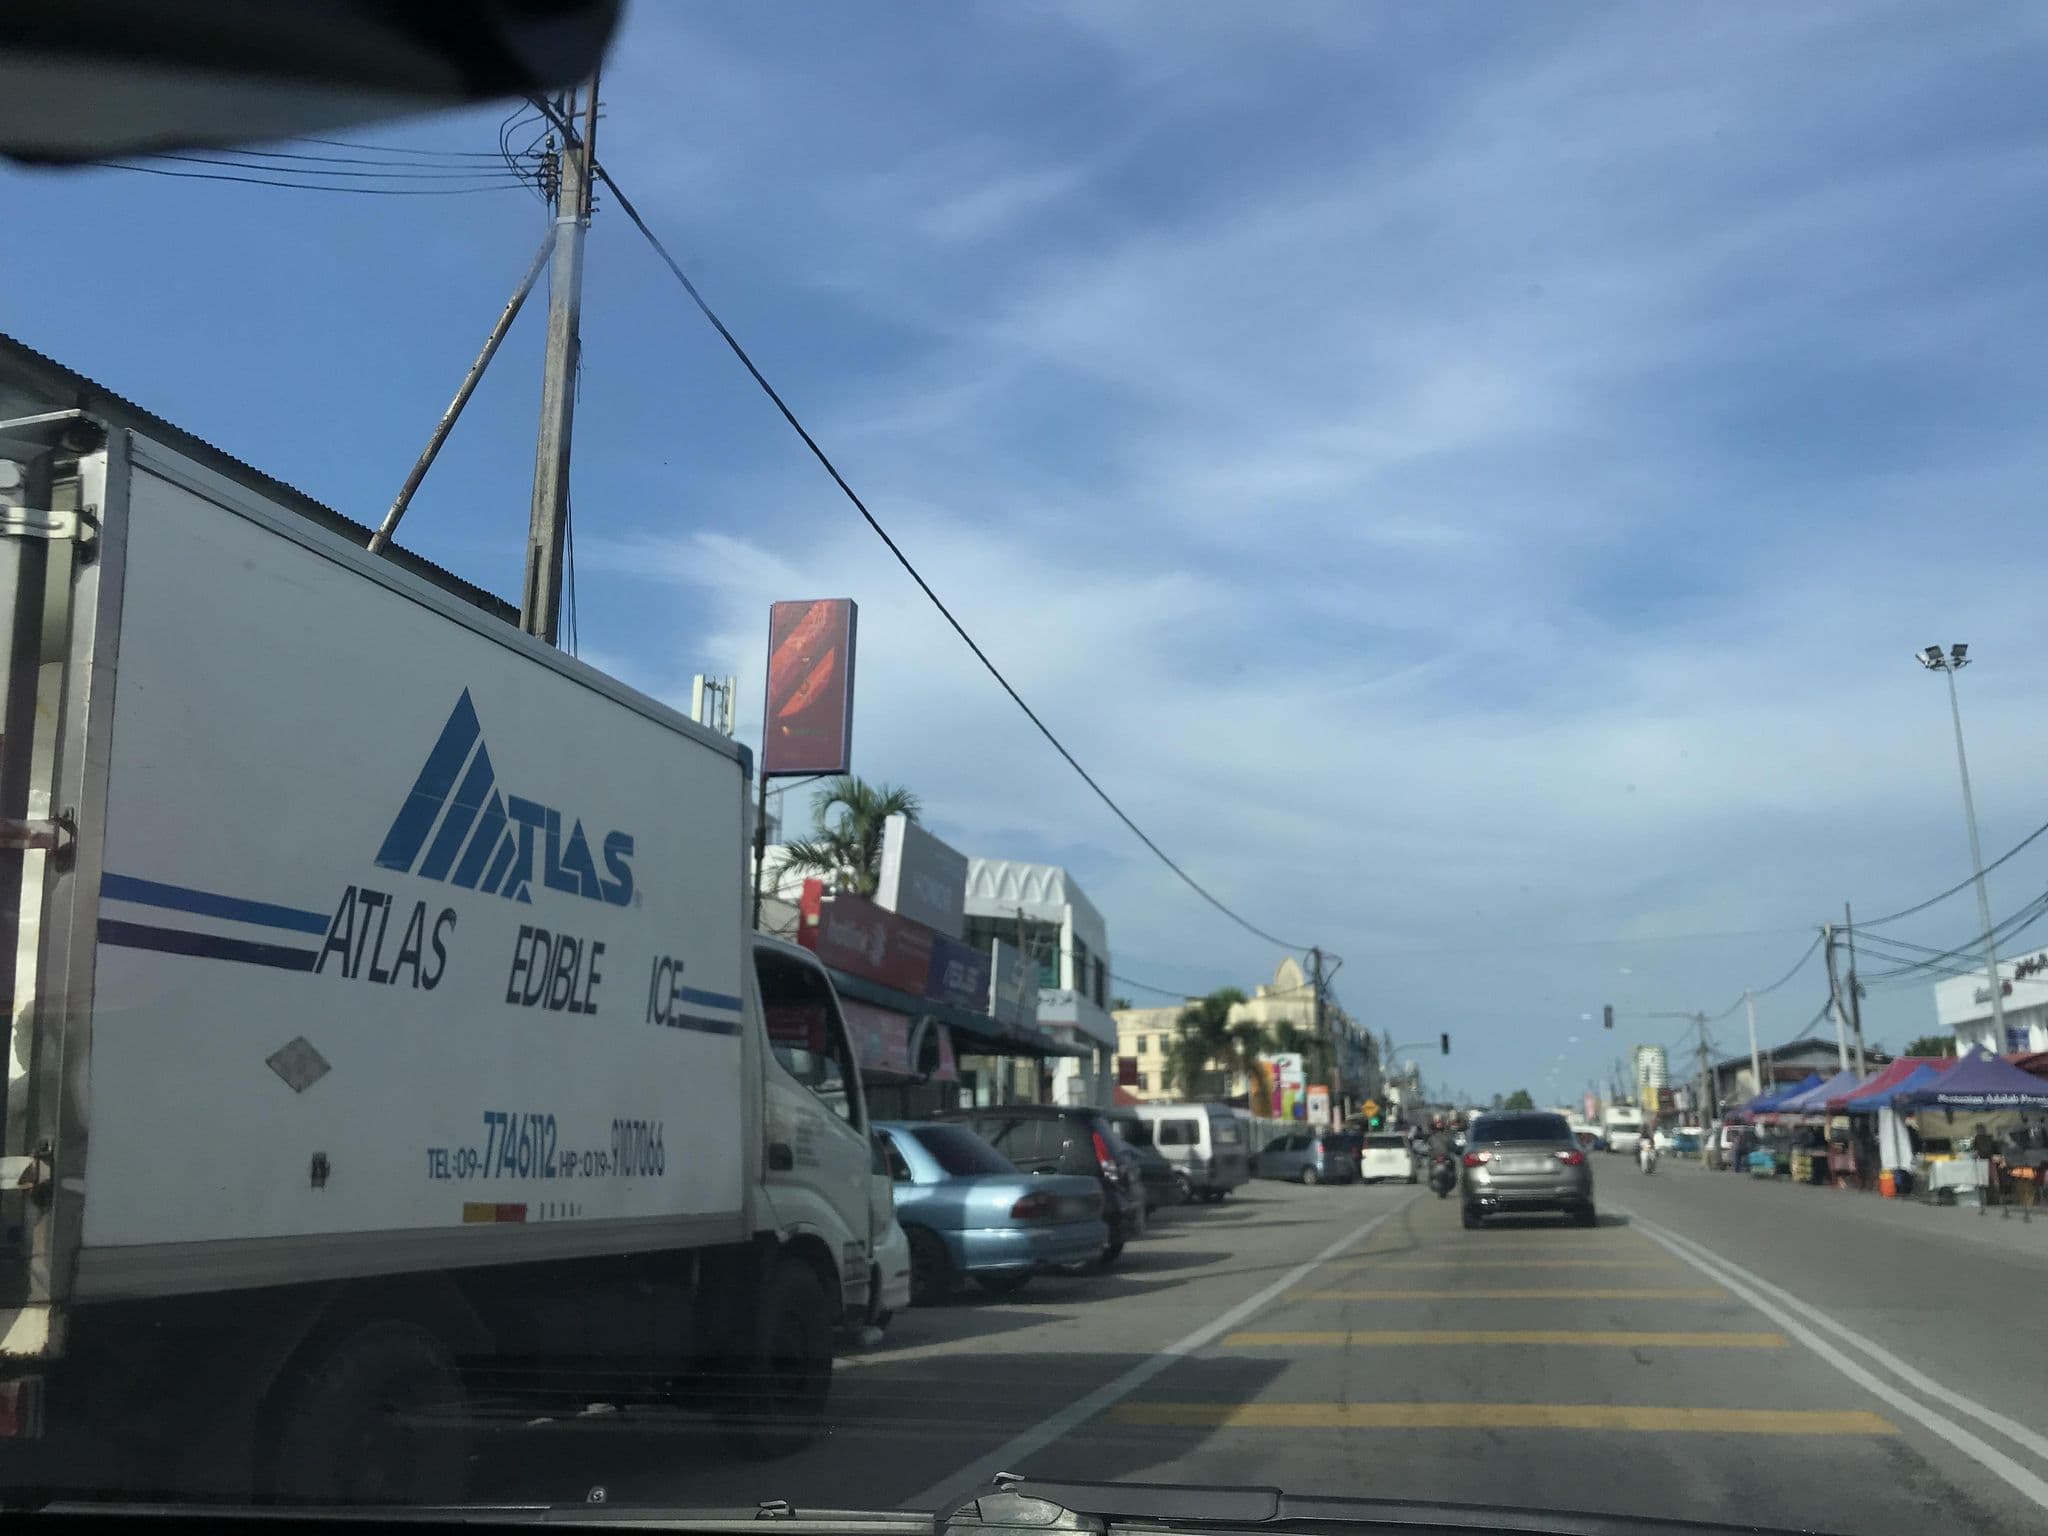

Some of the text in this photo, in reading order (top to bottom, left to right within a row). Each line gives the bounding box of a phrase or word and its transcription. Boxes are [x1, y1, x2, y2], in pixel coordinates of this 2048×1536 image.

[375, 686, 635, 906] ATLAS
[315, 886, 685, 1028] ATLAS EDIBLE ICE
